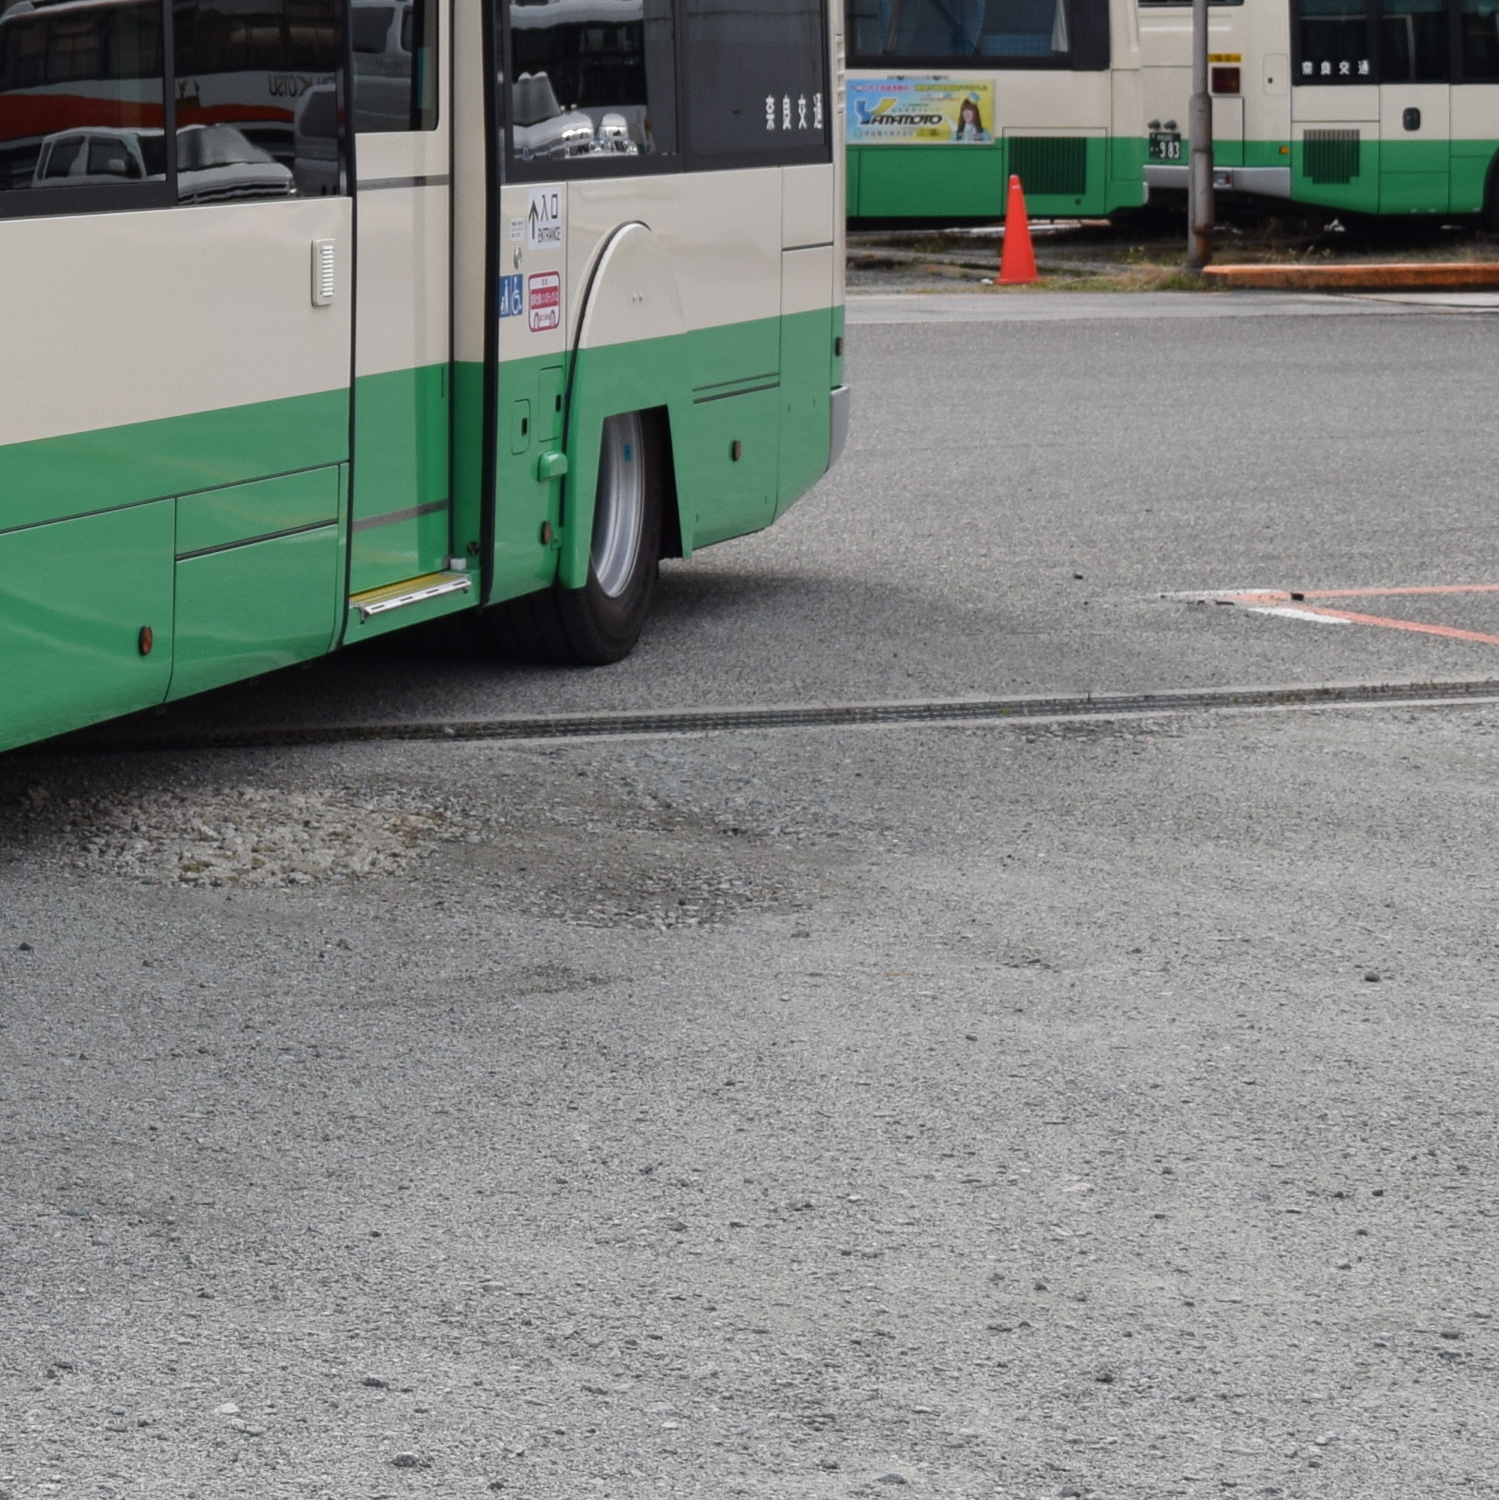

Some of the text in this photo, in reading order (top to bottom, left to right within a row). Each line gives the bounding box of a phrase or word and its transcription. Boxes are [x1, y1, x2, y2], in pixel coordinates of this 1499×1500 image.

[1301, 60, 1369, 75] 奈良交通
[765, 93, 822, 131] 奈良交通
[540, 194, 558, 222] 入口
[537, 226, 561, 244] ENTRANCE
